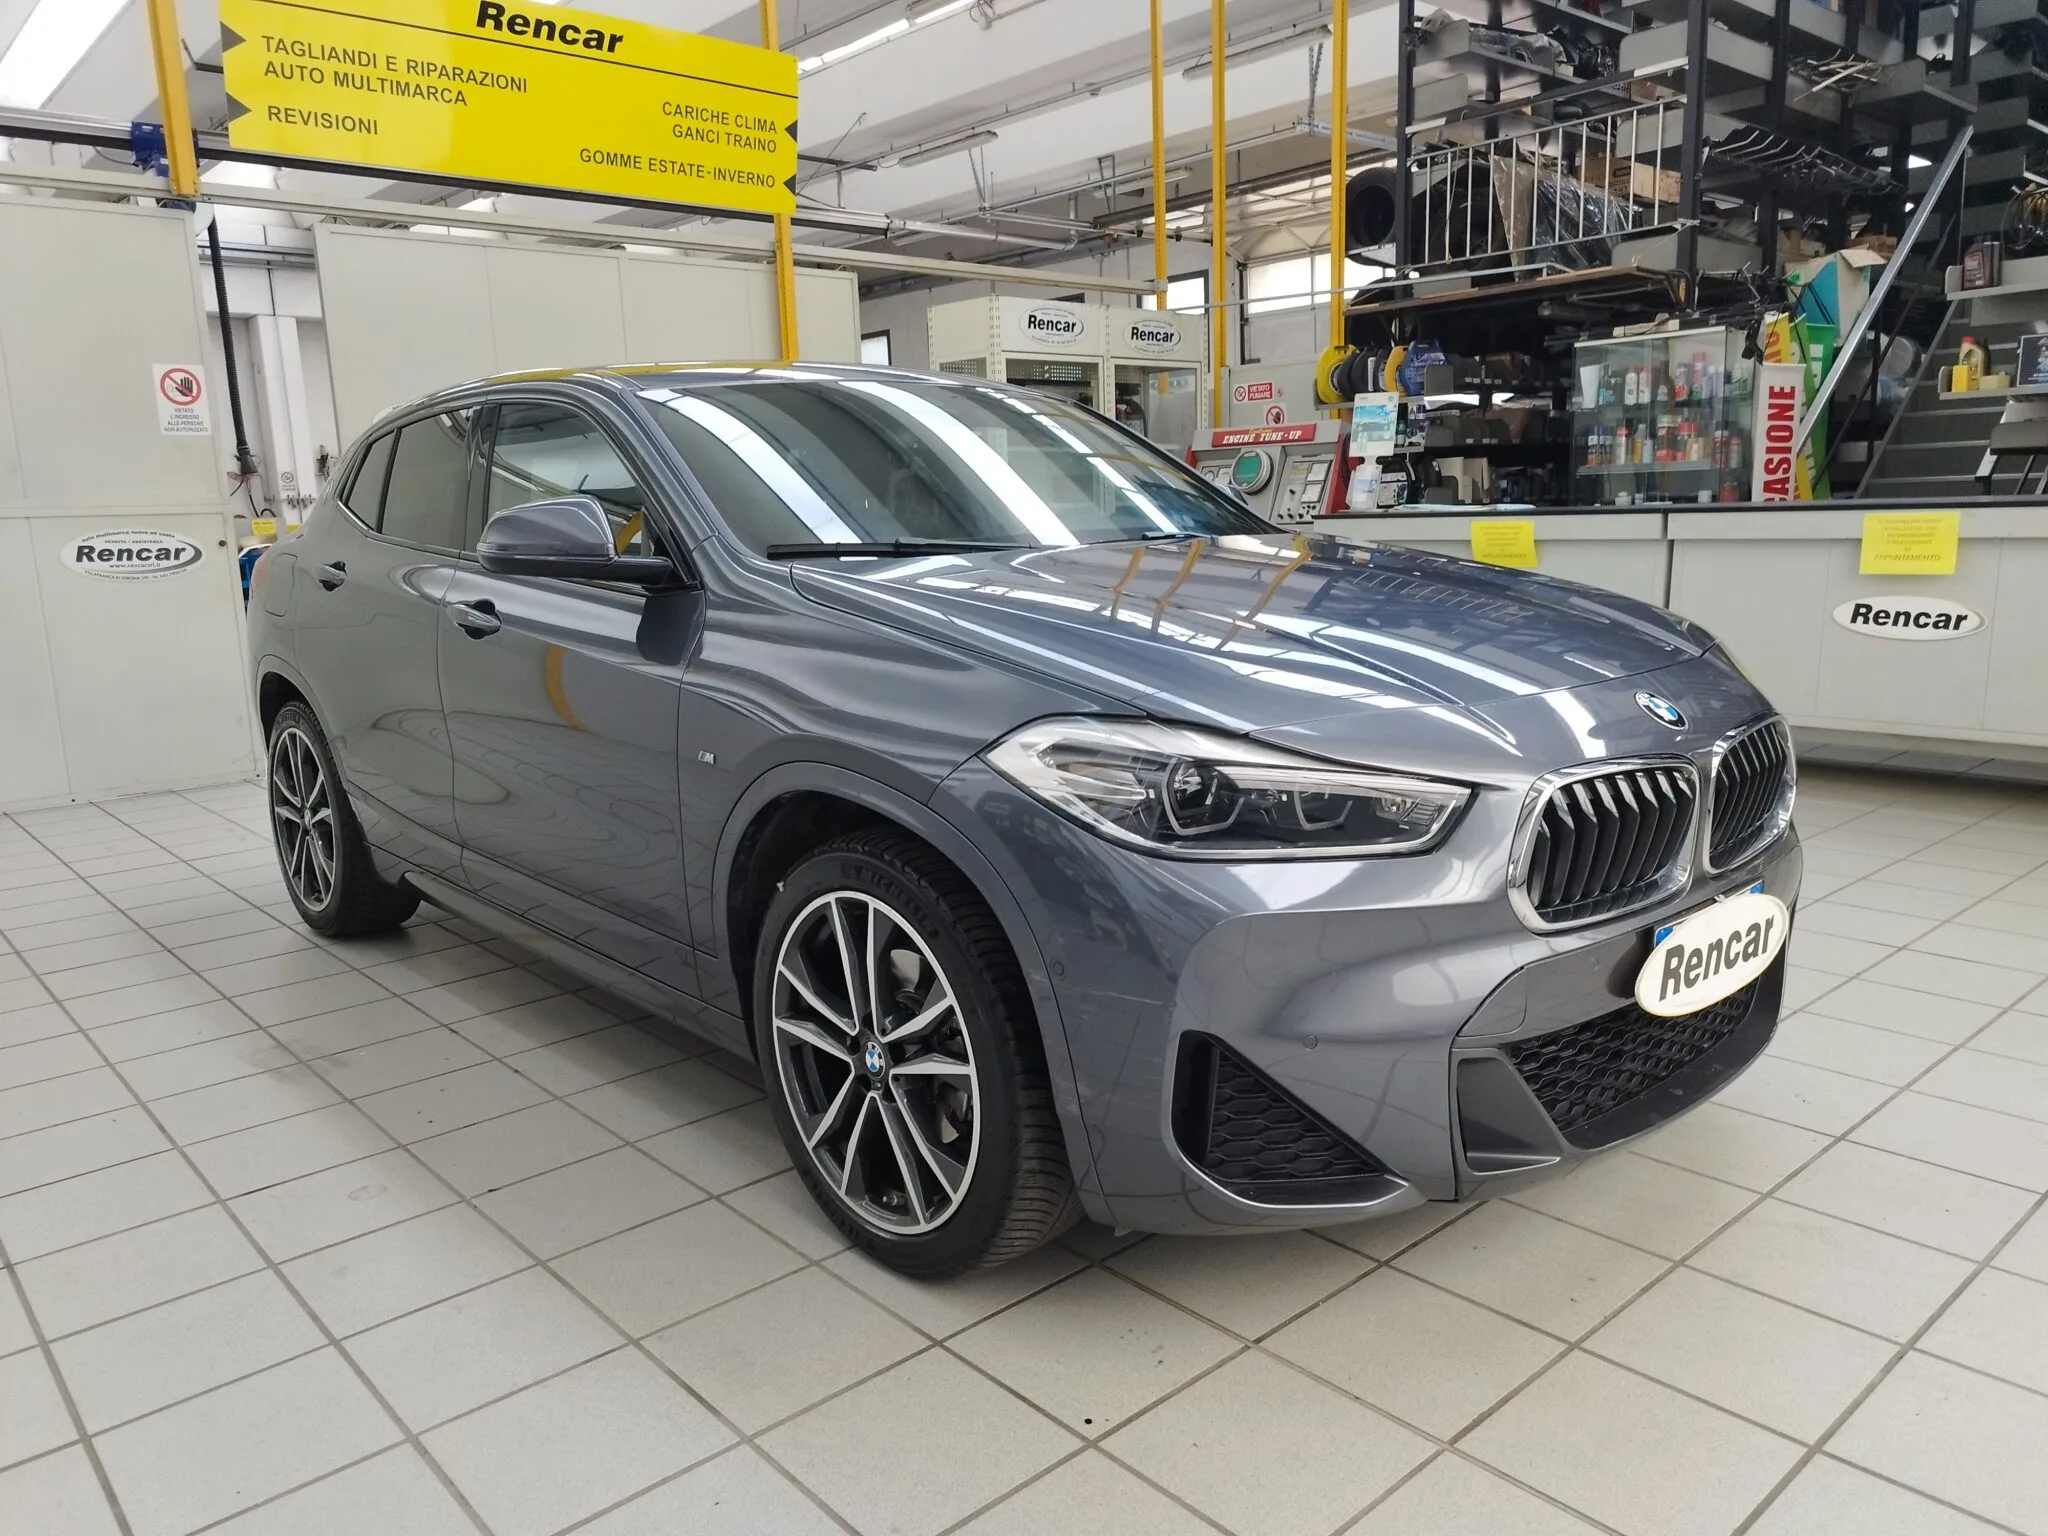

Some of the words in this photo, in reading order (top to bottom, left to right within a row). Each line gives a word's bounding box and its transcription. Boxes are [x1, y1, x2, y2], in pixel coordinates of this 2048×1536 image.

[475, 0, 624, 54] Rencar
[261, 35, 377, 69] TAGLIANDI
[386, 56, 398, 72] E
[406, 59, 527, 93] RIPARAZIONI
[264, 61, 325, 84] AUTO
[333, 71, 468, 106] MULTIMARCA
[267, 105, 378, 135] REVISIONI
[662, 101, 730, 126] CARICHE
[734, 115, 777, 134] CLIMA
[672, 124, 720, 144] GANCI
[724, 132, 777, 153] TRAINO
[579, 148, 642, 170] GOMME
[648, 157, 775, 188] ESTATE-INVERNO
[1028, 314, 1076, 333] Rencar
[1131, 326, 1174, 343] Rencar
[1249, 384, 1270, 393] VIETATO
[1222, 433, 1256, 445] ENGINE
[1763, 385, 1796, 502] ASIONE
[75, 545, 187, 563] Rencar
[1850, 603, 1968, 630] Rencar
[1659, 913, 1775, 1003] Rencar
